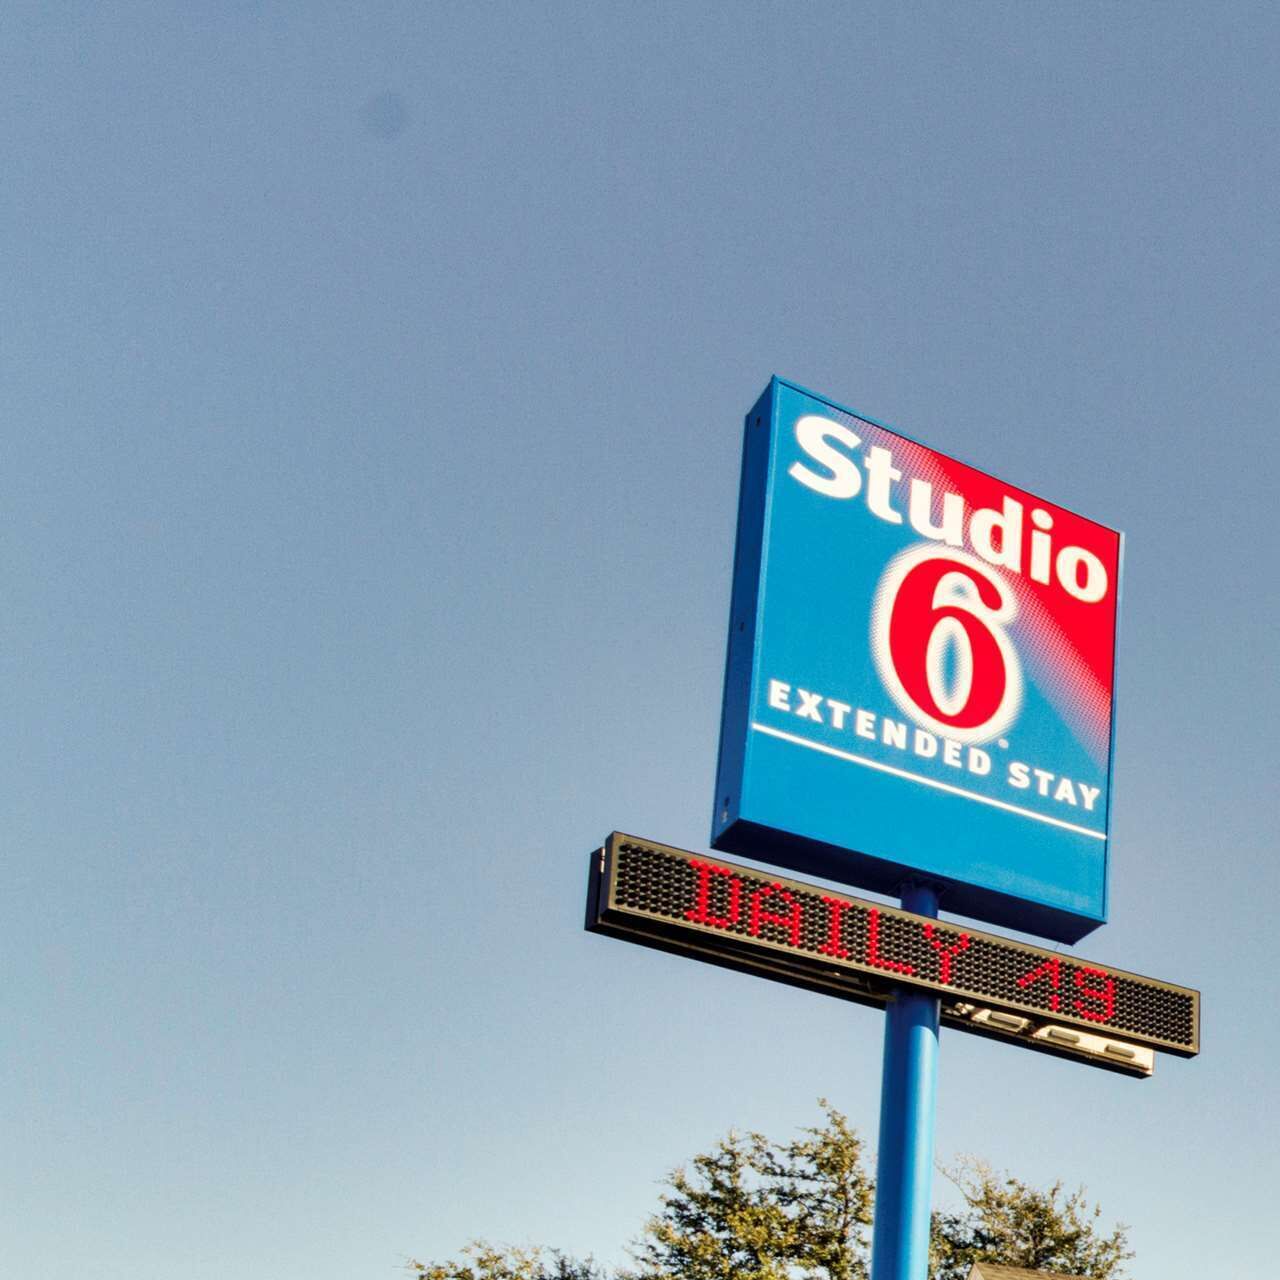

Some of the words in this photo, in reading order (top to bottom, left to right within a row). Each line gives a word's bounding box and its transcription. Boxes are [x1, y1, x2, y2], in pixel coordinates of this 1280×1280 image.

[788, 413, 1109, 604] Studio
[879, 548, 1016, 739] 6
[768, 678, 991, 776] EXTENDED
[1008, 761, 1101, 812] STAY
[685, 857, 971, 985] DAILY
